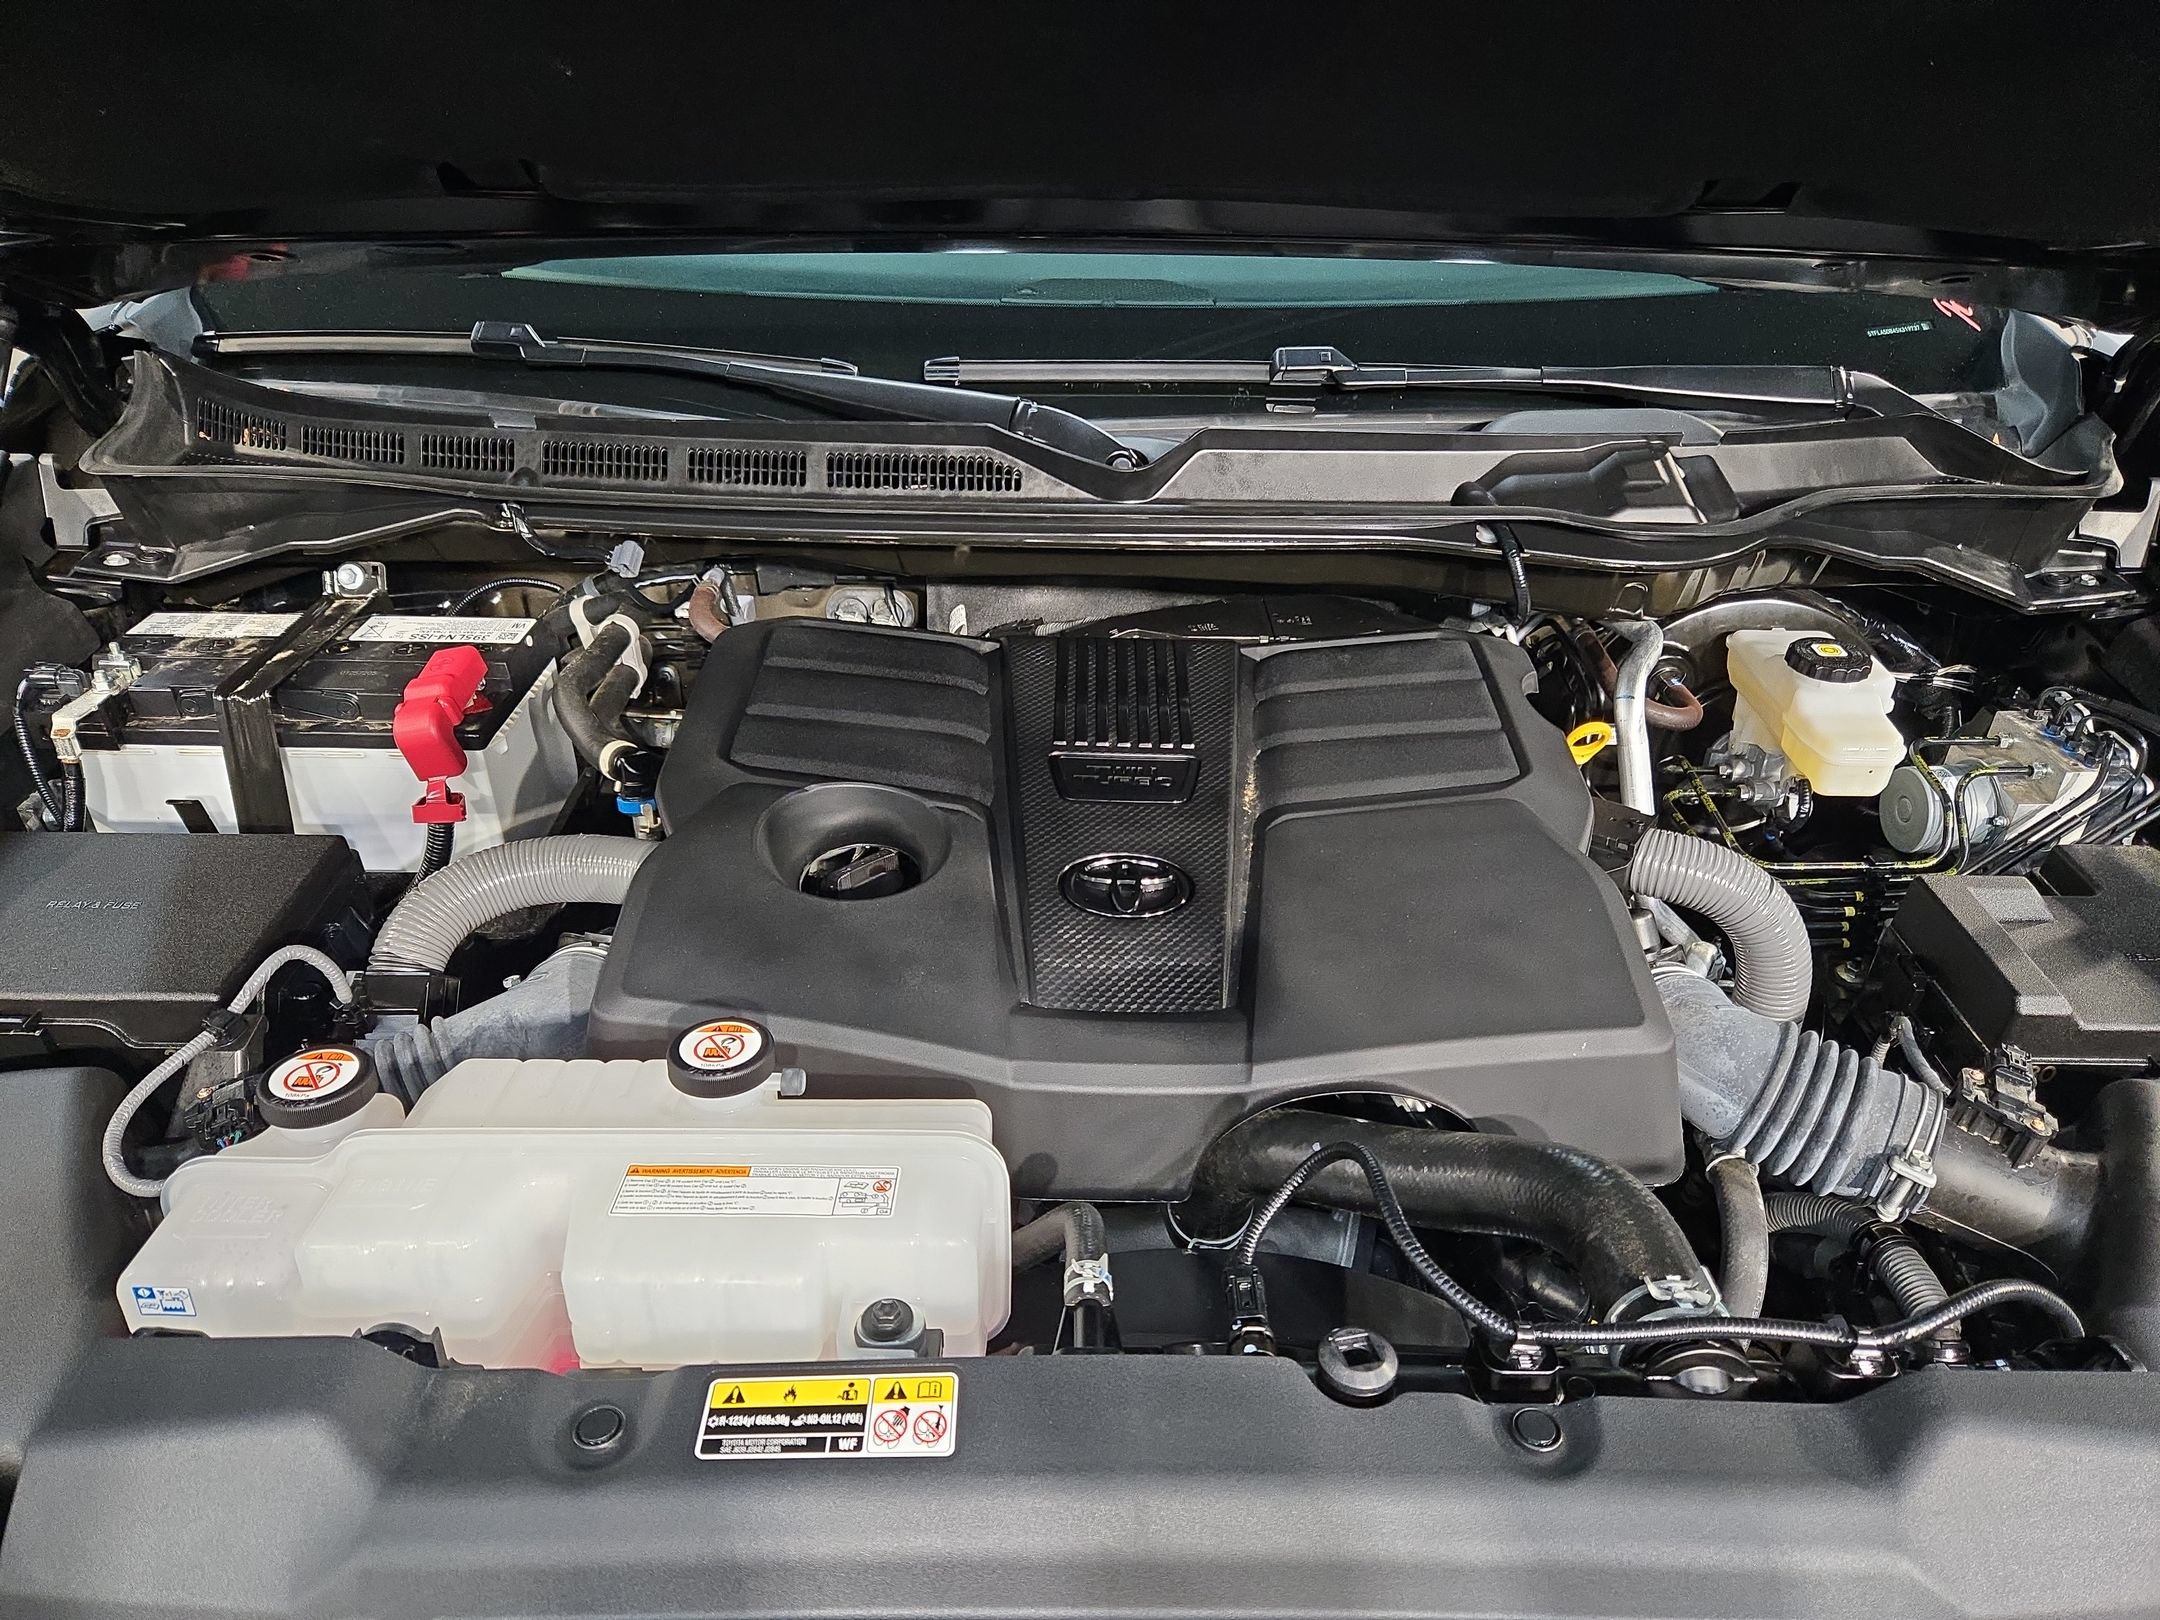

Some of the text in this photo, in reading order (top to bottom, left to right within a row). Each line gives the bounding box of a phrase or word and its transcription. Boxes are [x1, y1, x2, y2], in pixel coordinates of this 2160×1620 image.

[46, 900, 91, 909] RELAY
[103, 901, 143, 910] FUSE
[838, 1438, 858, 1451] WF
